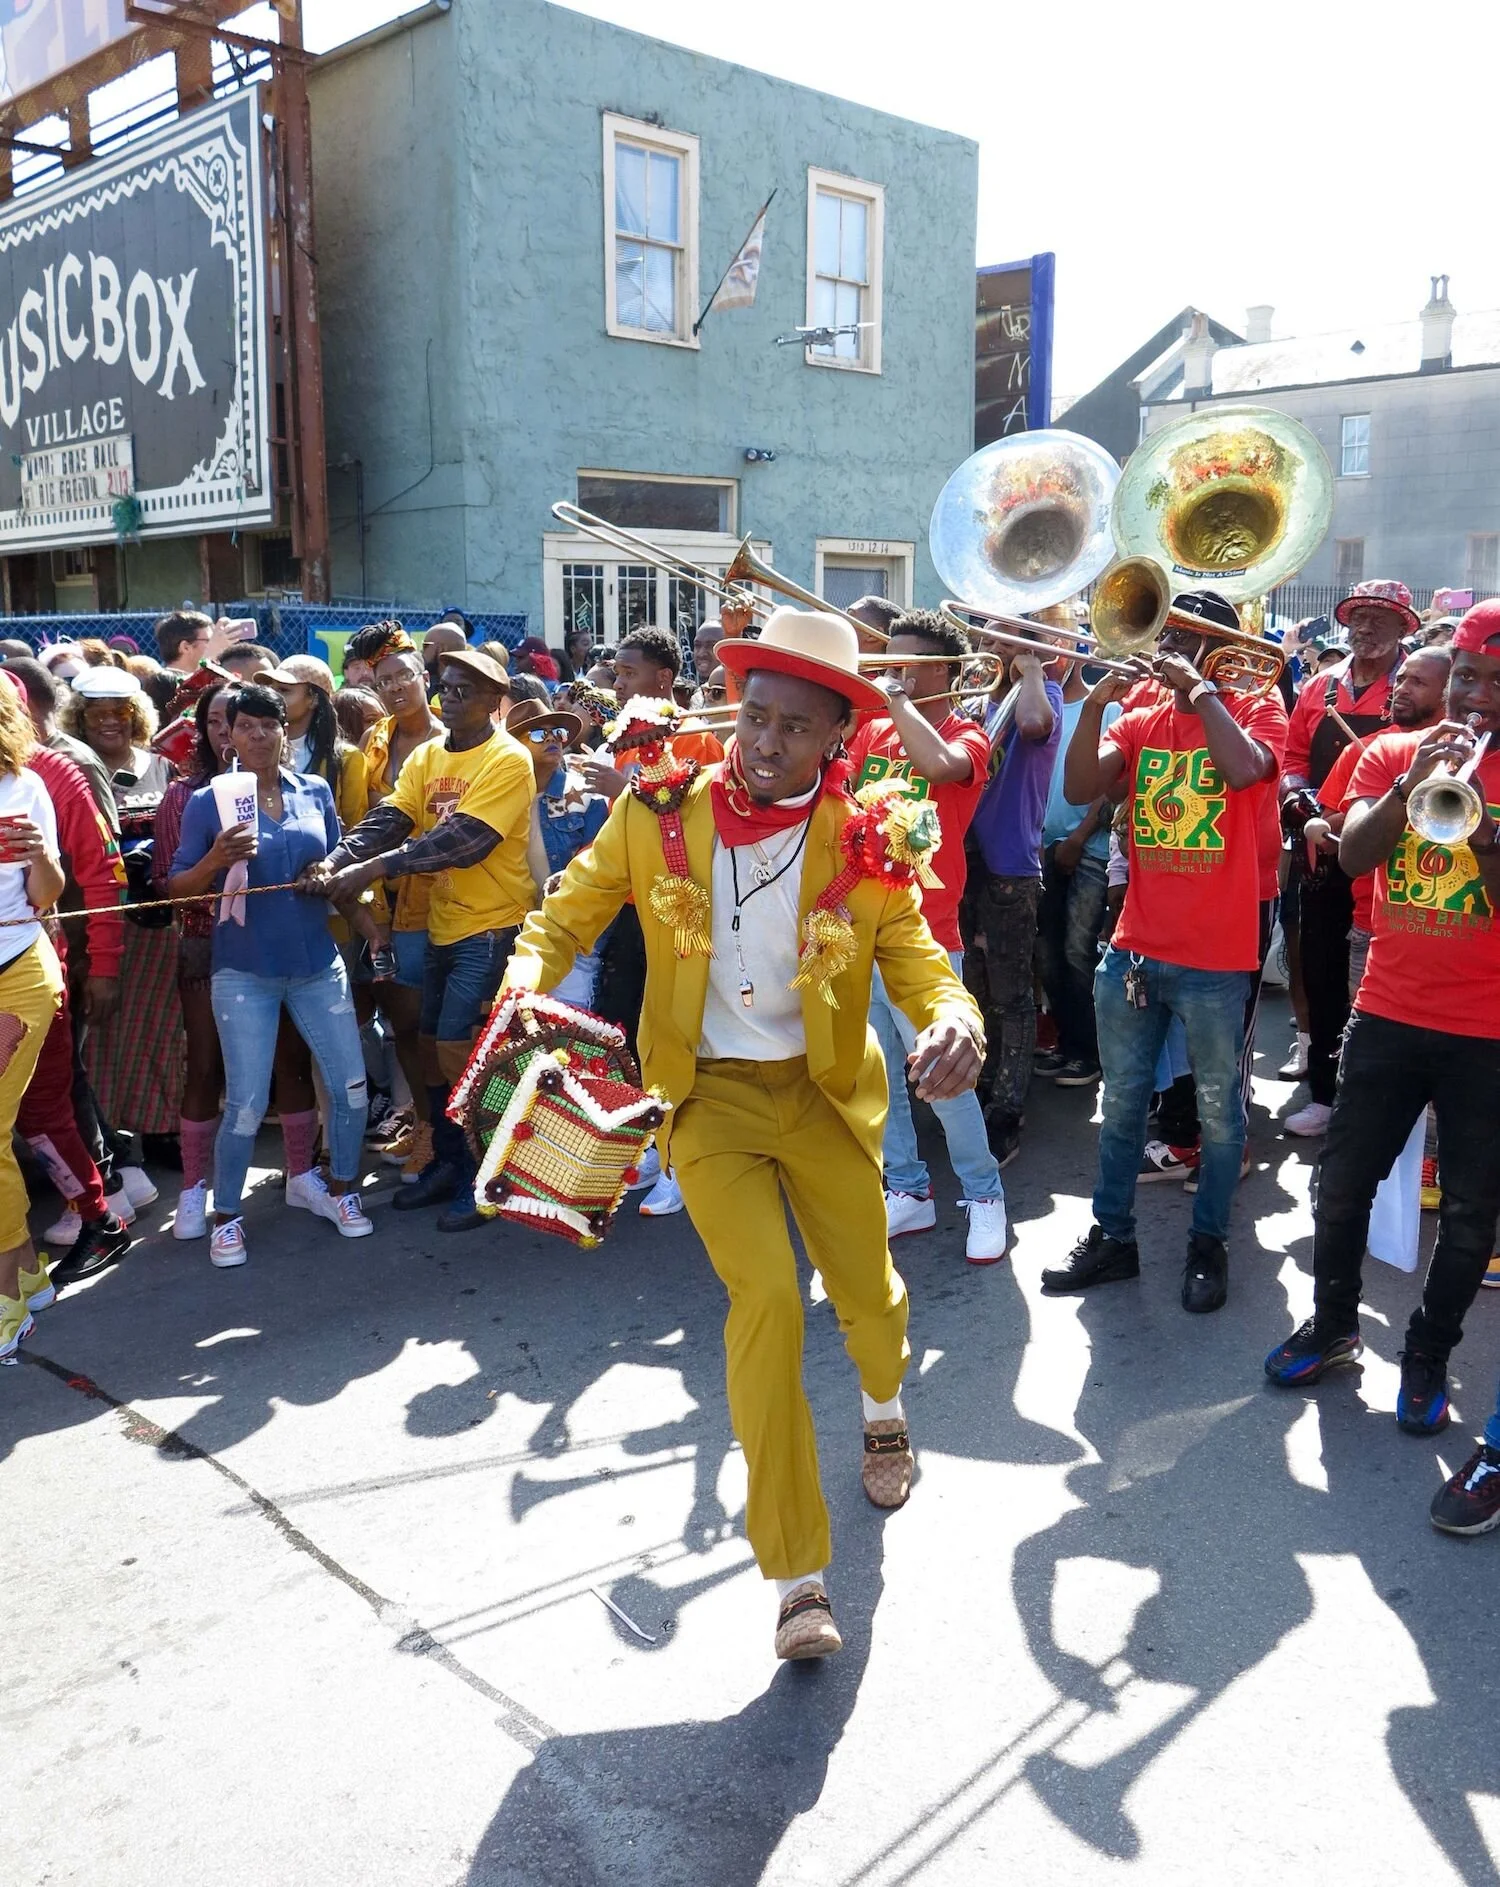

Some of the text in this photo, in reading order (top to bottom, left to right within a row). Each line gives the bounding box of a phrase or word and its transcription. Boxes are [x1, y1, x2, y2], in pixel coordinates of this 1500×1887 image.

[25, 397, 125, 447] VILLAGE
[61, 448, 87, 475] GRAS
[93, 442, 118, 469] BALL
[1174, 566, 1194, 576] Music
[235, 794, 255, 806] FAT
[236, 804, 255, 814] TUE
[237, 812, 255, 822] DAY
[1180, 851, 1224, 864] BAND
